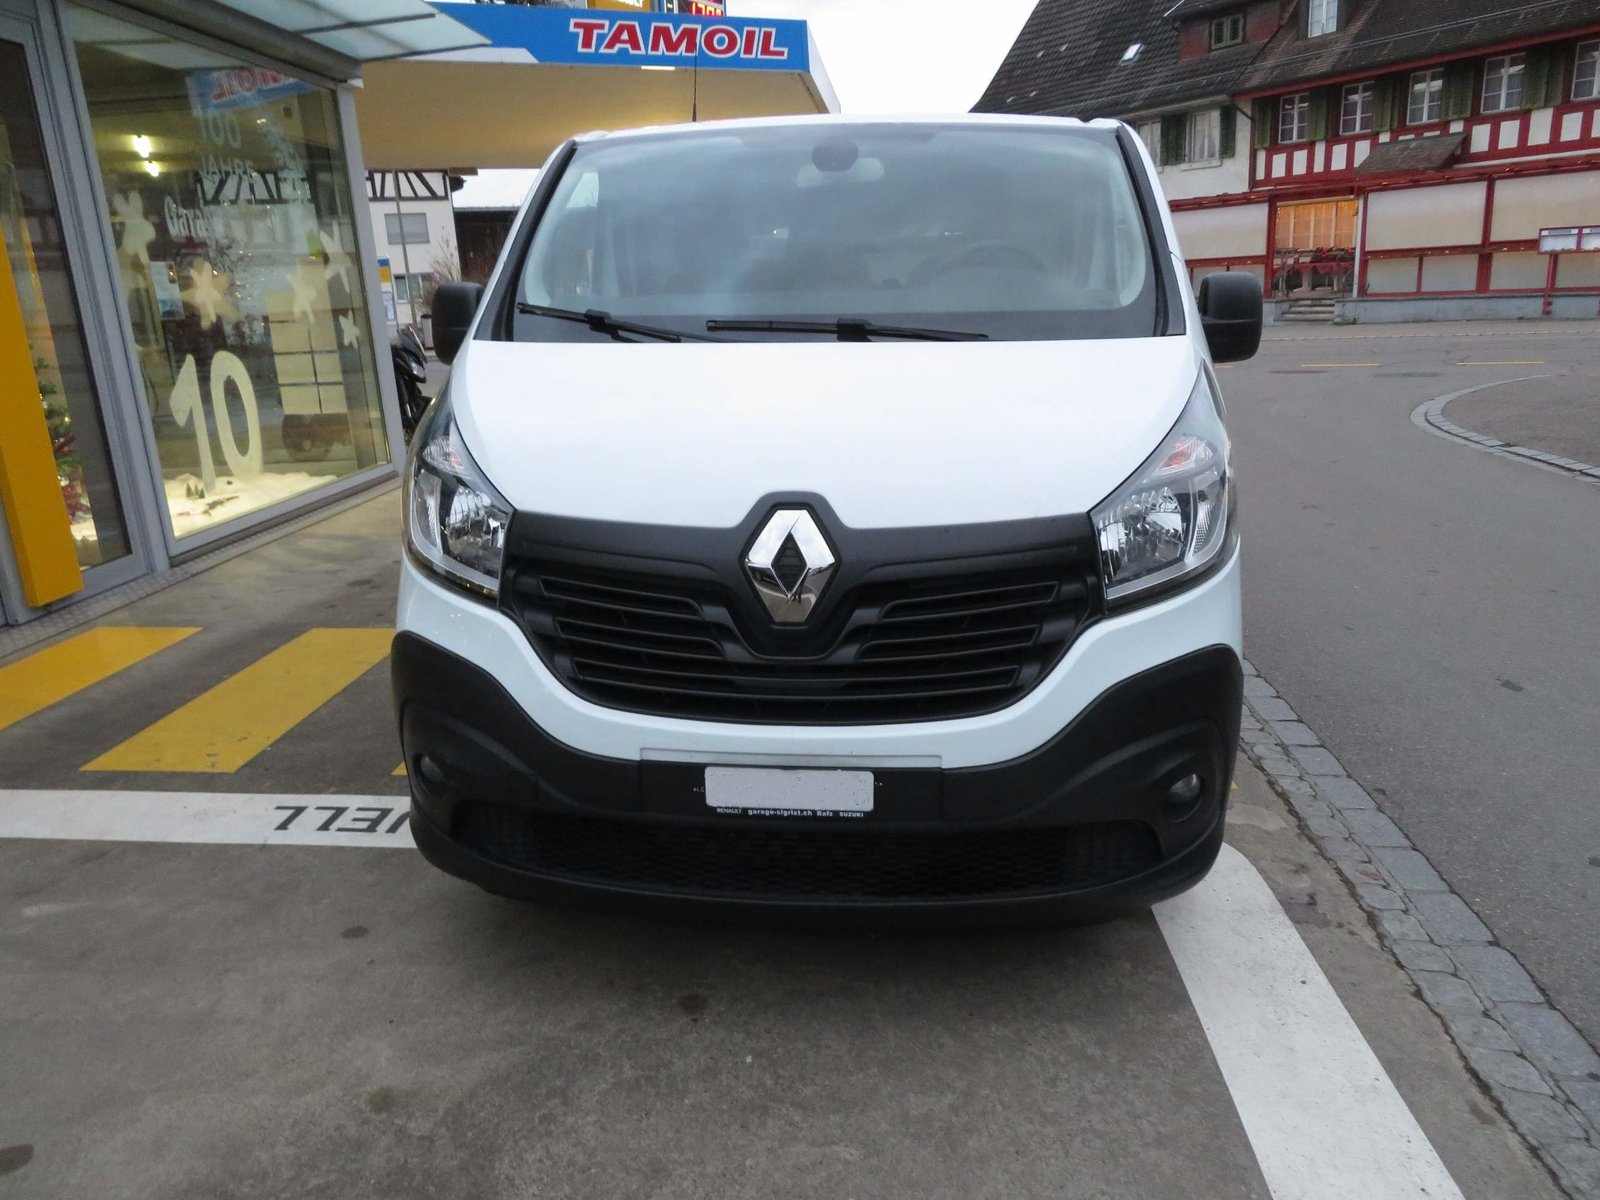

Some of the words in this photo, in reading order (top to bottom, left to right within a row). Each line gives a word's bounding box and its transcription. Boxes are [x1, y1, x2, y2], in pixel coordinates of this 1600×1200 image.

[570, 18, 789, 59] TAMOIL
[169, 351, 264, 492] 10
[748, 808, 813, 817] garage-sigrist.ch
